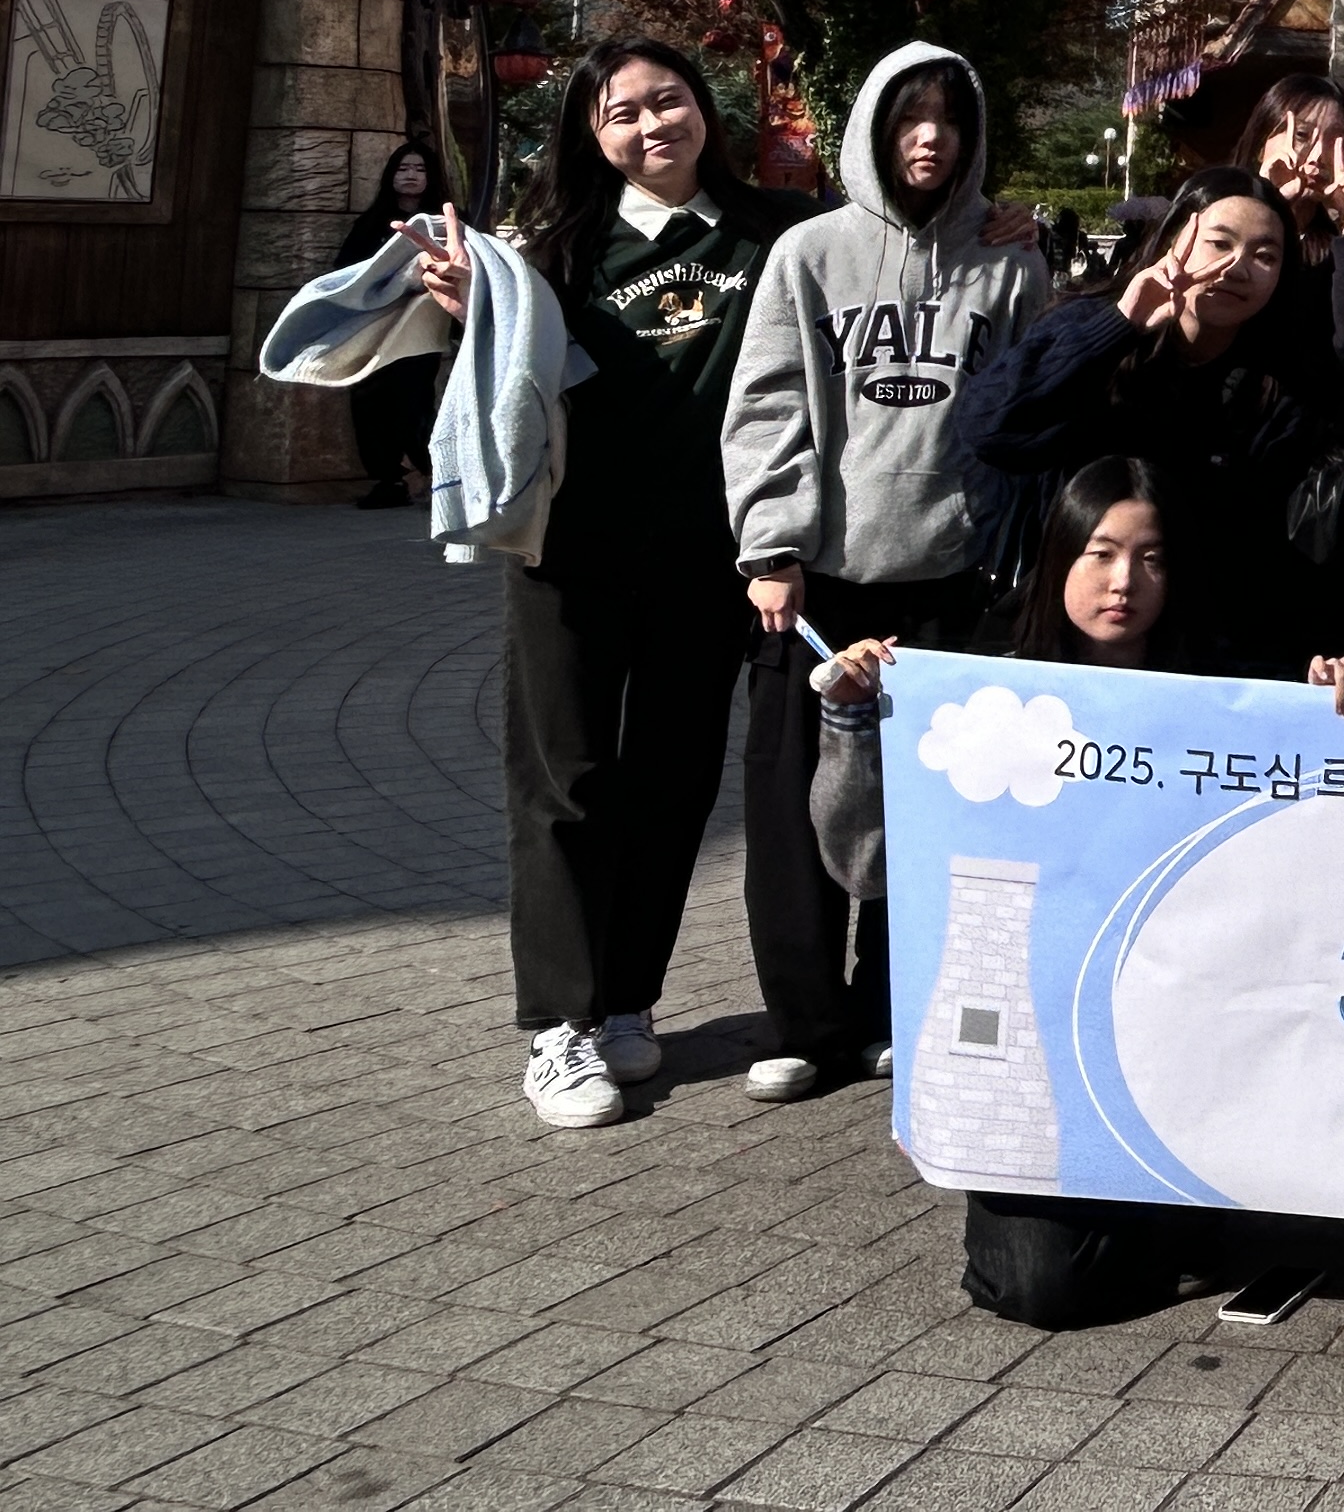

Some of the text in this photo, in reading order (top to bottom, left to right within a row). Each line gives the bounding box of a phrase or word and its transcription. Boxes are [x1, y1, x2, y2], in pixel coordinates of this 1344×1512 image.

[908, 384, 936, 400] 1701
[1054, 740, 1164, 789] 2025.
[1180, 749, 1301, 801] 구도심
